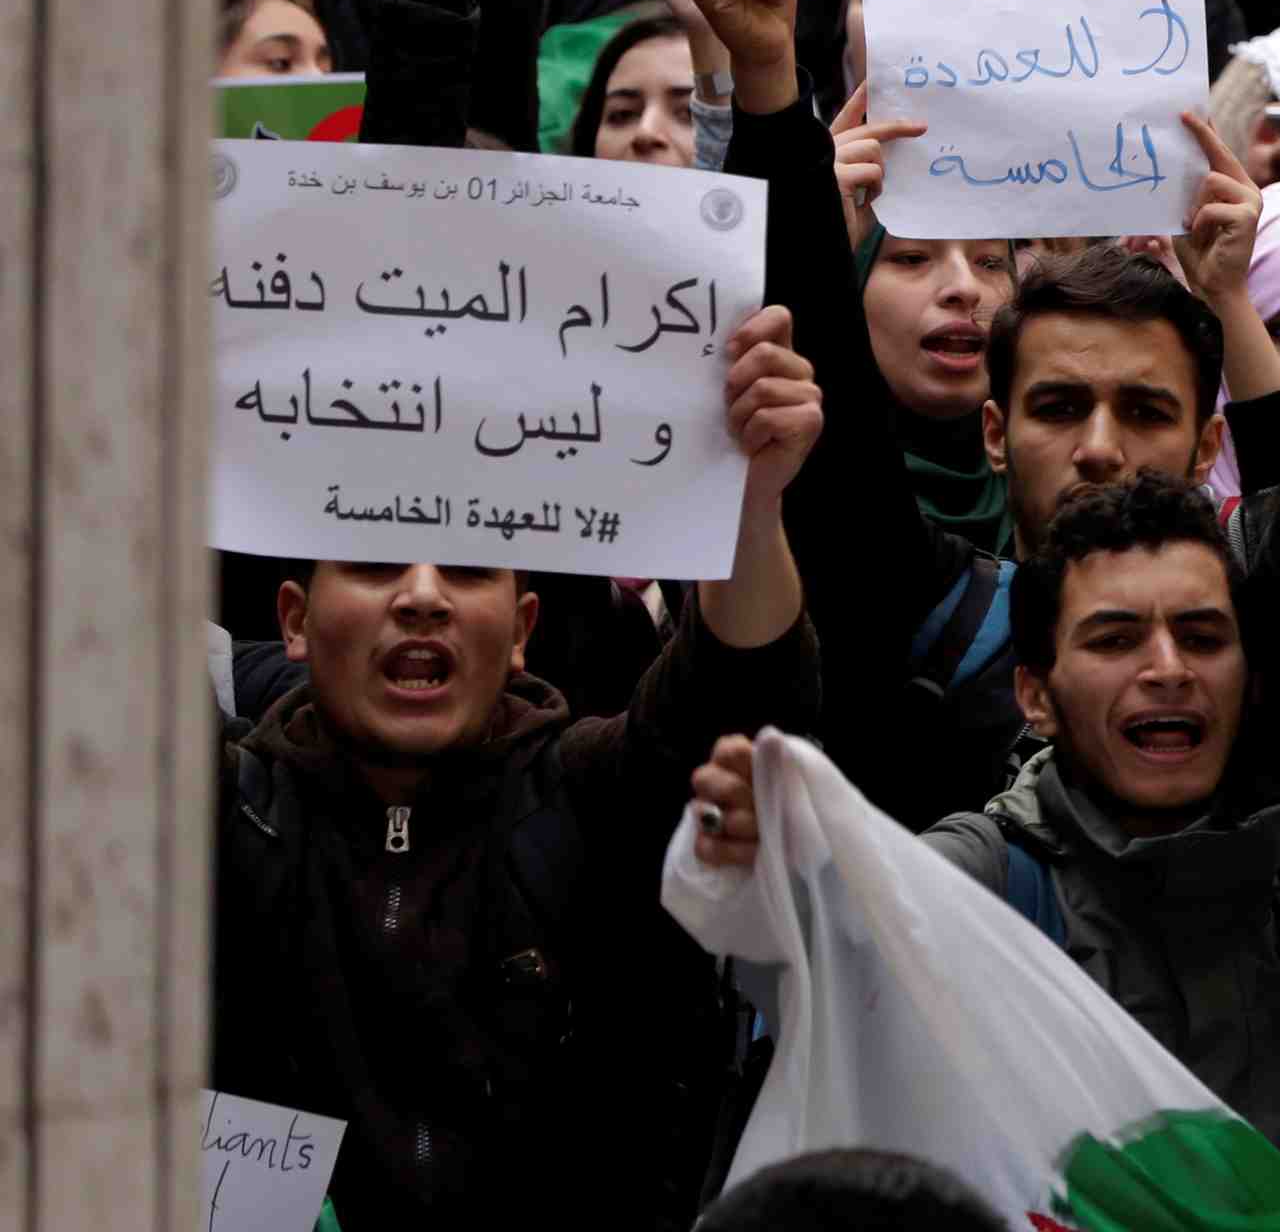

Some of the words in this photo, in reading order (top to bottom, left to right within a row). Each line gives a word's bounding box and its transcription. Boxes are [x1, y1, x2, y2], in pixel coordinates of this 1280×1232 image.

[903, 16, 1100, 89] للعهدة
[286, 169, 324, 189] خدة
[928, 121, 1168, 193] الخامسة
[330, 172, 358, 196] بن
[362, 172, 427, 200] يوسف
[433, 178, 460, 201] بن
[580, 179, 642, 211] جامعة
[354, 260, 527, 338] الميت
[557, 271, 719, 359] إكرام
[234, 368, 443, 441] انتخابه
[474, 381, 603, 460] ليس
[630, 418, 673, 466] و
[323, 486, 452, 528] الخامسة
[465, 504, 561, 541] للعهدة
